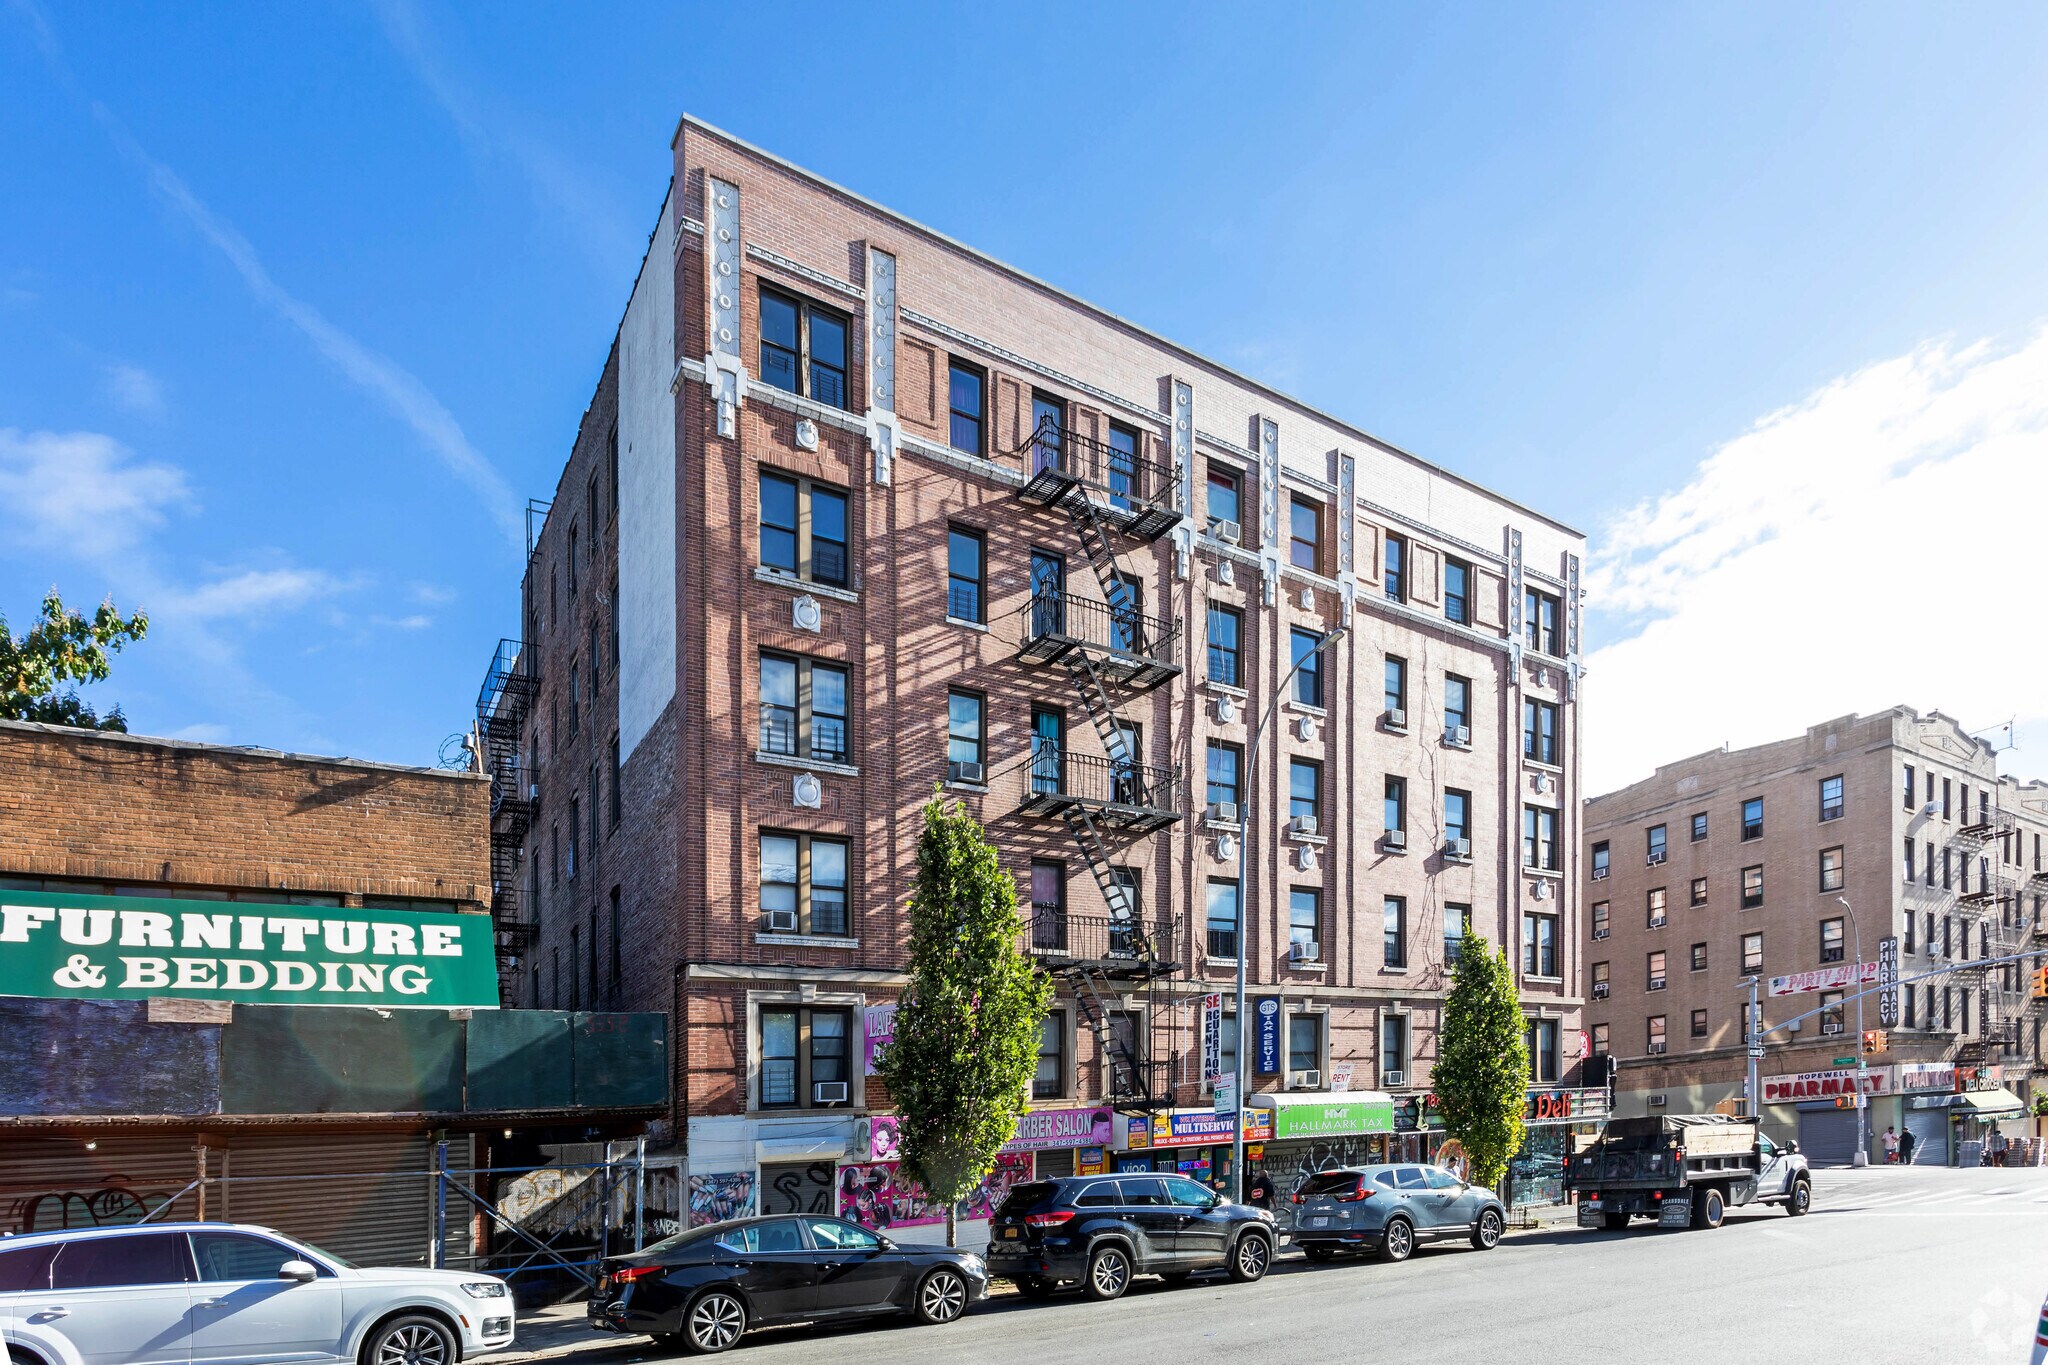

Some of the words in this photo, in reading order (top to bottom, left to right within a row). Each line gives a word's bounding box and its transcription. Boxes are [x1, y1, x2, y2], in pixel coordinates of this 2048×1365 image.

[0, 905, 463, 957] FURNITURE
[53, 954, 107, 988] &
[118, 957, 433, 995] BEDDING
[1788, 969, 1832, 989] PARTY
[1880, 941, 1889, 1024] PHARMACY
[1205, 994, 1220, 1010] SE
[1260, 1003, 1276, 1012] GTS
[868, 1010, 898, 1038] LAP
[1263, 1015, 1274, 1031] TAX
[1204, 1010, 1213, 1080] RENTAN
[1212, 1009, 1220, 1076] CUARTOS
[1263, 1034, 1274, 1072] SERVICE
[1332, 1073, 1351, 1083] RENT
[1797, 1070, 1850, 1081] HOPEWELL
[1535, 1093, 1572, 1119] Deli
[1013, 1114, 1053, 1141] ARBER
[1055, 1112, 1092, 1137] SALON
[1174, 1120, 1234, 1134] MULTISERVIC
[1191, 1115, 1215, 1123] INTERNA
[1289, 1119, 1357, 1132] HALLMARK
[1361, 1117, 1383, 1128] TAX
